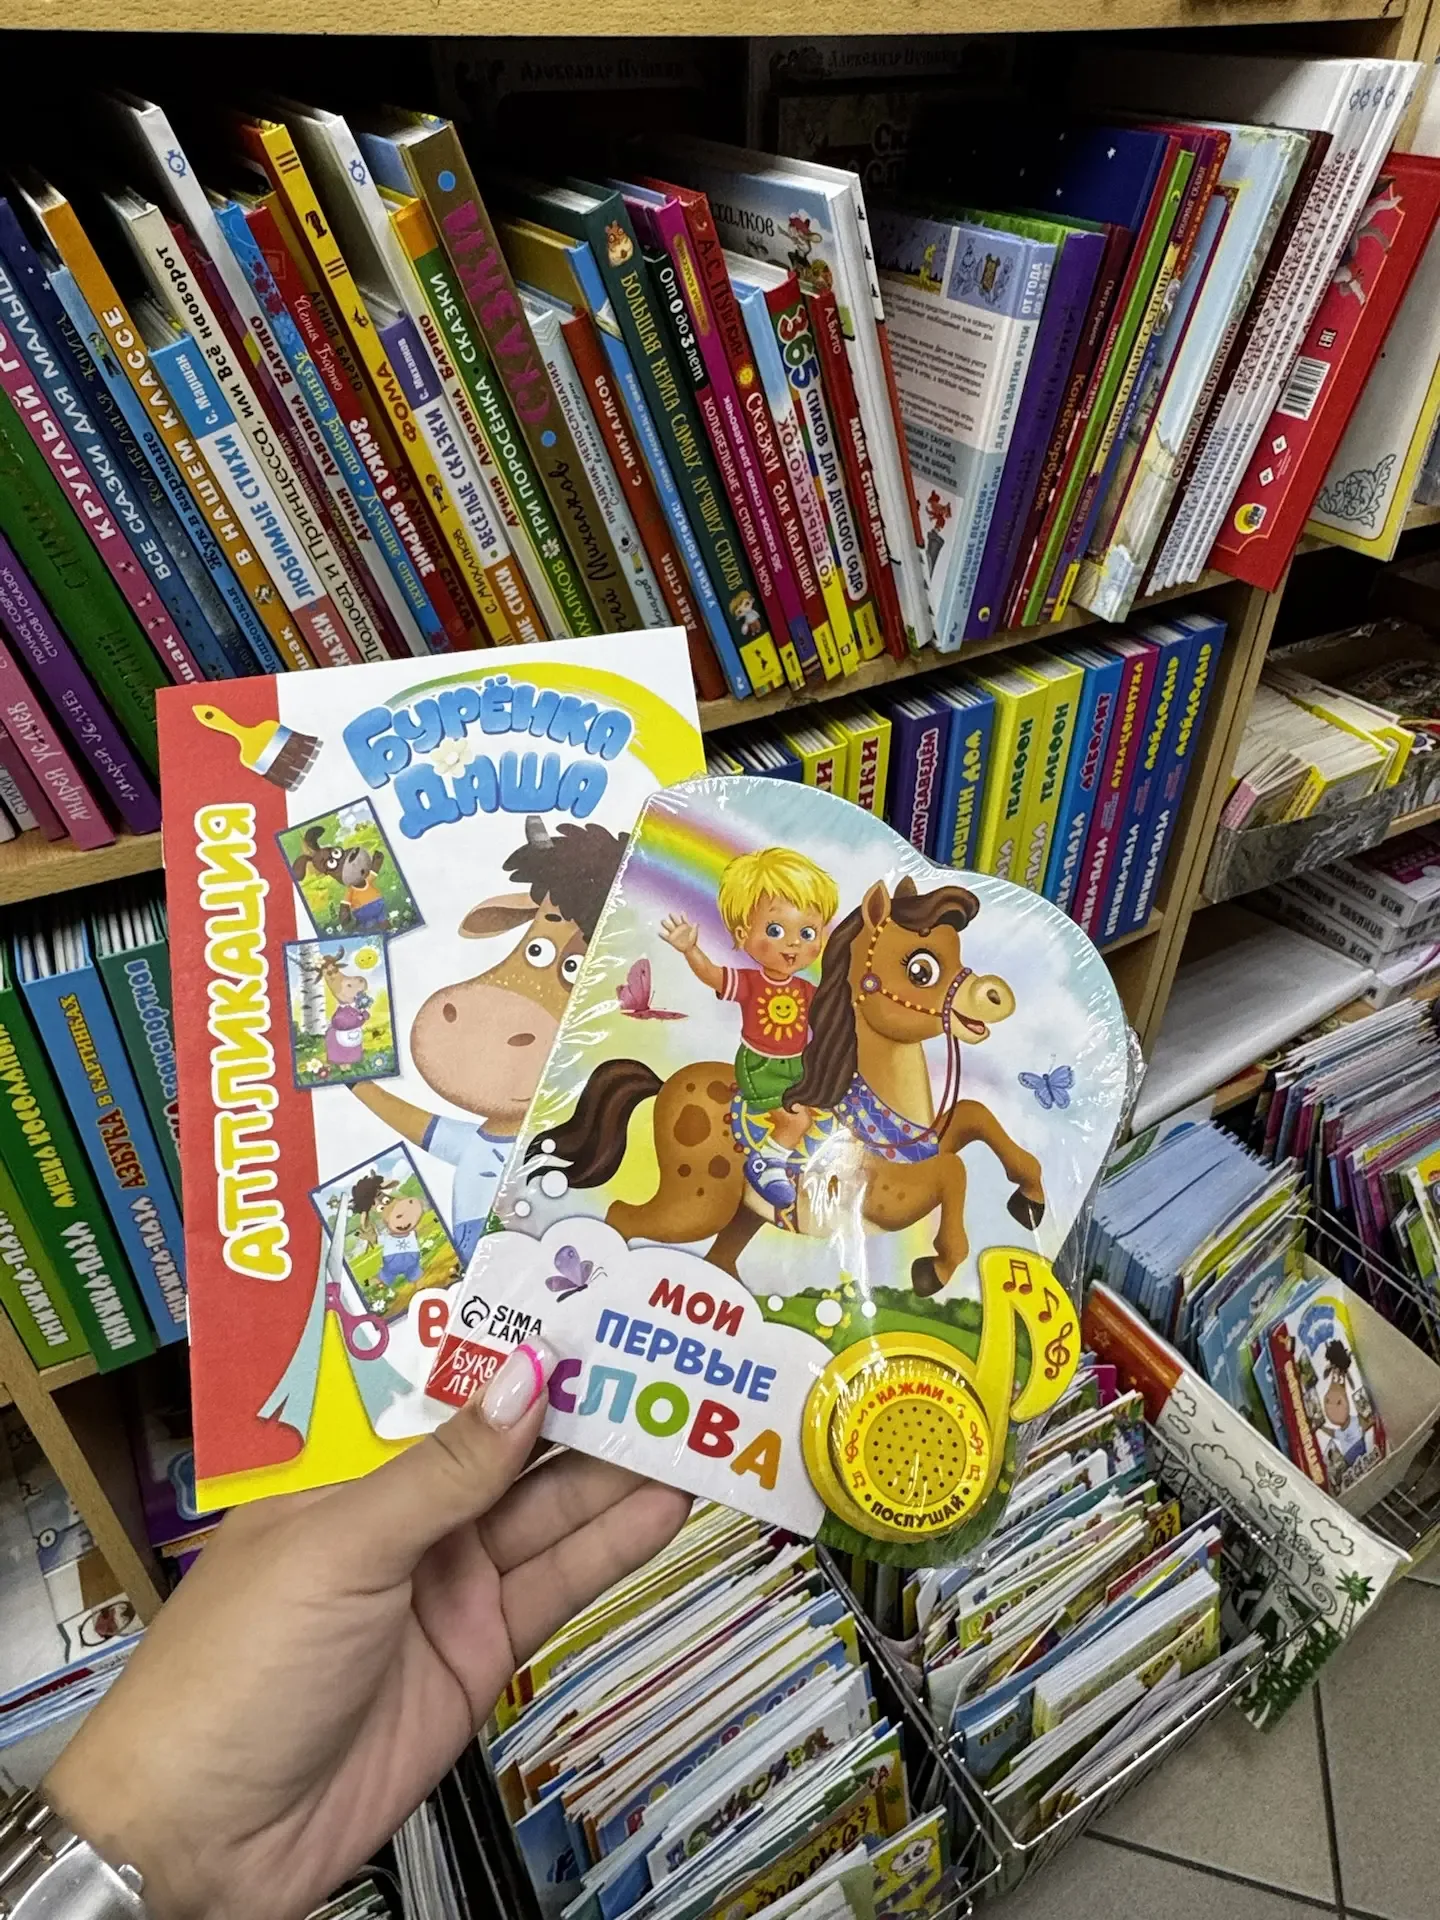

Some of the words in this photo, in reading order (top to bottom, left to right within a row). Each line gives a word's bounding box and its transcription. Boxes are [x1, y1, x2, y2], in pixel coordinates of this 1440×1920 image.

[152, 242, 215, 341] наоборот
[656, 265, 681, 301] От
[666, 297, 686, 314] 0
[1018, 297, 1034, 314] ОТ
[1022, 259, 1045, 298] ГОДА
[0, 264, 62, 382] МАЛЫШ
[427, 270, 479, 365] СКАЗКИ
[436, 197, 557, 431] СКАЗКИ
[670, 311, 692, 336] до
[678, 332, 697, 349] 3
[1013, 322, 1033, 358] РЕЧИ
[100, 302, 180, 430] КЛАССЕ
[204, 343, 235, 381] Всё
[393, 335, 427, 390] Михалков
[682, 346, 707, 383] лет
[770, 302, 825, 393] 365
[51, 381, 97, 441] ДЛЯ
[170, 351, 213, 410] Маршак
[228, 383, 255, 419] или
[371, 359, 422, 445] ФОМА
[544, 358, 596, 462] НЕПОСЛУШАНИЯ
[996, 356, 1026, 423] РАЗВИТИЯ
[201, 407, 221, 426] С.
[422, 405, 472, 481] СКАЗКИ
[469, 373, 535, 499] ПОРОСЁНКА
[589, 372, 640, 469] МИХАЛКОВ
[617, 269, 665, 355] БОЛЬШАЯ
[647, 355, 683, 412] КНИГА
[666, 411, 705, 473] САМЫХ
[689, 473, 726, 536] ЛУЧШИХ
[711, 537, 745, 591] СТИХОВ
[698, 395, 743, 492] КОЛЫБЕЛЬНЫЕ
[719, 393, 746, 445] девочек
[799, 386, 834, 449] СТИХОВ
[844, 415, 872, 470] МАМА.
[988, 421, 1009, 451] ДЛЯ
[1098, 392, 1128, 454] СКАЗКА
[9, 382, 118, 543] КРУГЛЫЙ
[138, 428, 195, 513] кармане
[211, 431, 263, 502] СТИХИ
[344, 415, 395, 485] ЗАЙКА
[741, 390, 785, 473] Сказки
[768, 478, 793, 513] для
[816, 450, 843, 488] ДЛЯ
[1170, 424, 1198, 479] Сказки
[84, 441, 148, 537] СКАЗКИ
[172, 435, 240, 542] НАШЕМ
[185, 512, 200, 528] в
[245, 417, 333, 561] Принцесса,
[379, 484, 400, 503] В
[454, 479, 502, 551] ВЕСЁЛЫЕ
[525, 499, 553, 538] ТРИ
[543, 454, 618, 585] Михалков
[586, 461, 620, 524] ПРАЗДНИК
[743, 469, 765, 508] стихов
[773, 415, 840, 588] КОТЕНЬКА-КОТОК
[856, 470, 883, 519] СТИХИ
[190, 525, 225, 571] Жук
[247, 498, 316, 603] ЛЮБИМЫЕ
[386, 500, 438, 579] ВИТРИНЕ
[735, 505, 761, 550] СТИХИ
[758, 516, 779, 555] сказок
[824, 486, 859, 555] ДЕТСКОГО
[867, 519, 893, 568] ДЕТЯМ
[0, 565, 31, 609] СКАЗОК
[137, 536, 174, 582] ВСЕ
[232, 546, 254, 567] В
[325, 562, 340, 579] и
[449, 526, 493, 601] МИХАЛКОВ
[657, 550, 685, 594] СТЁПА
[748, 547, 765, 566] НА
[754, 564, 776, 598] НОЧЬ
[841, 553, 867, 595] САДА
[481, 595, 500, 615] С.
[490, 563, 530, 617] СТИХИ
[14, 620, 48, 665] ПОЛНОЕ
[27, 614, 59, 659] СТИХОВ
[223, 584, 281, 677] Мошковская
[330, 580, 386, 667] Людоед
[343, 677, 633, 789] БУРЁНКА
[960, 725, 985, 786] ДОМ
[1037, 698, 1071, 806] ТЕЛЕФОН
[1076, 690, 1113, 792] АЙБОЛИТ
[1105, 659, 1147, 790] МУХА-ЦОКОТУХА
[43, 763, 96, 826] АНДРЕЙ
[398, 750, 608, 839] ДАША
[911, 724, 940, 815] ЗАВЕДЁМ
[1002, 715, 1036, 823] ТЕЛЕФОН
[1102, 820, 1143, 938] КНИЖКА-ПАЗЛ
[1140, 653, 1183, 771] МОЙДОДЫР
[1130, 805, 1172, 923] КНИЖКА-ПАЗЛ
[1175, 643, 1212, 757] МОЙДОДЫР
[54, 990, 112, 1096] КАРТИНКАХ
[198, 805, 291, 1279] АППЛИКАЦИЯ
[94, 1091, 115, 1109] В
[29, 1141, 79, 1213] МИШКА
[91, 1104, 149, 1196] АЗБУКА
[56, 1216, 139, 1352] КНИЖКА-ПАЗЛ
[124, 1192, 192, 1325] КНИЖКА-ПАЗЛ
[487, 1320, 542, 1346] LAN
[495, 1305, 543, 1333] SIMA
[648, 1278, 745, 1337] МОИ
[452, 1348, 500, 1381] БУКВ
[595, 1308, 777, 1402] ПЕРВЫЕ
[546, 1357, 783, 1491] СЛОВА
[875, 1382, 945, 1406] НАЖМИ
[870, 1493, 966, 1528] ПОСЛУШАЙ
